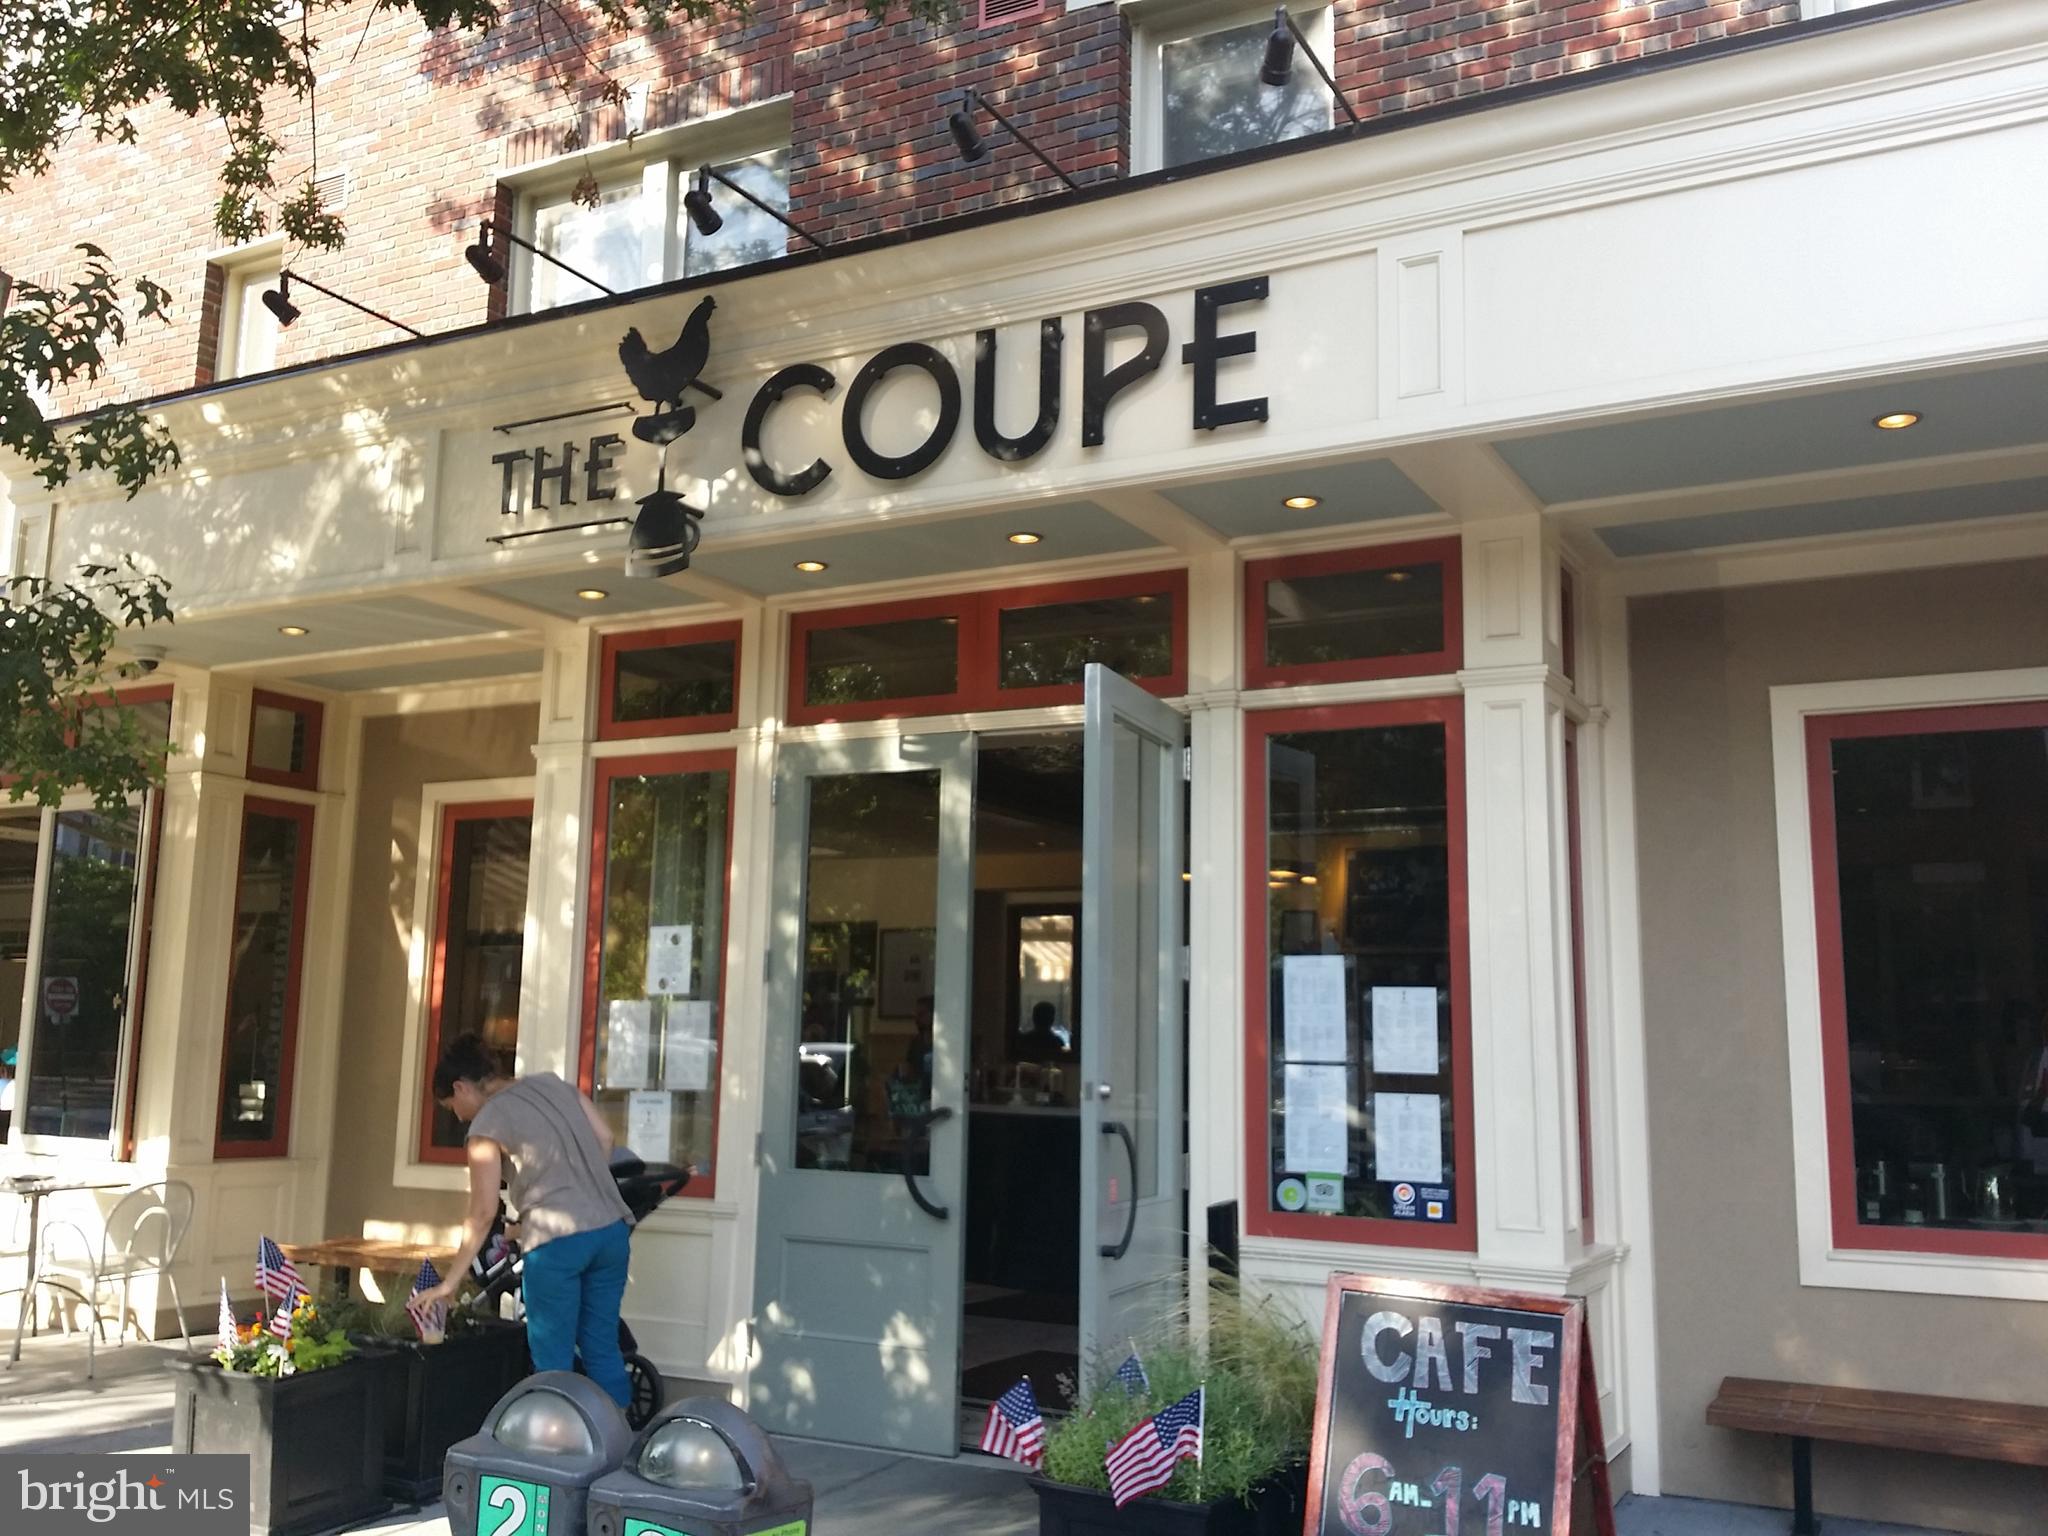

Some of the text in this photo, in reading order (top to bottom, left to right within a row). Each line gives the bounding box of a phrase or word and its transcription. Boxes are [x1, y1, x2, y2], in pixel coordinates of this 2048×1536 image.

[492, 275, 1270, 514] THE COUPE
[1361, 1311, 1554, 1405] CAFE
[488, 1484, 528, 1536] 2
